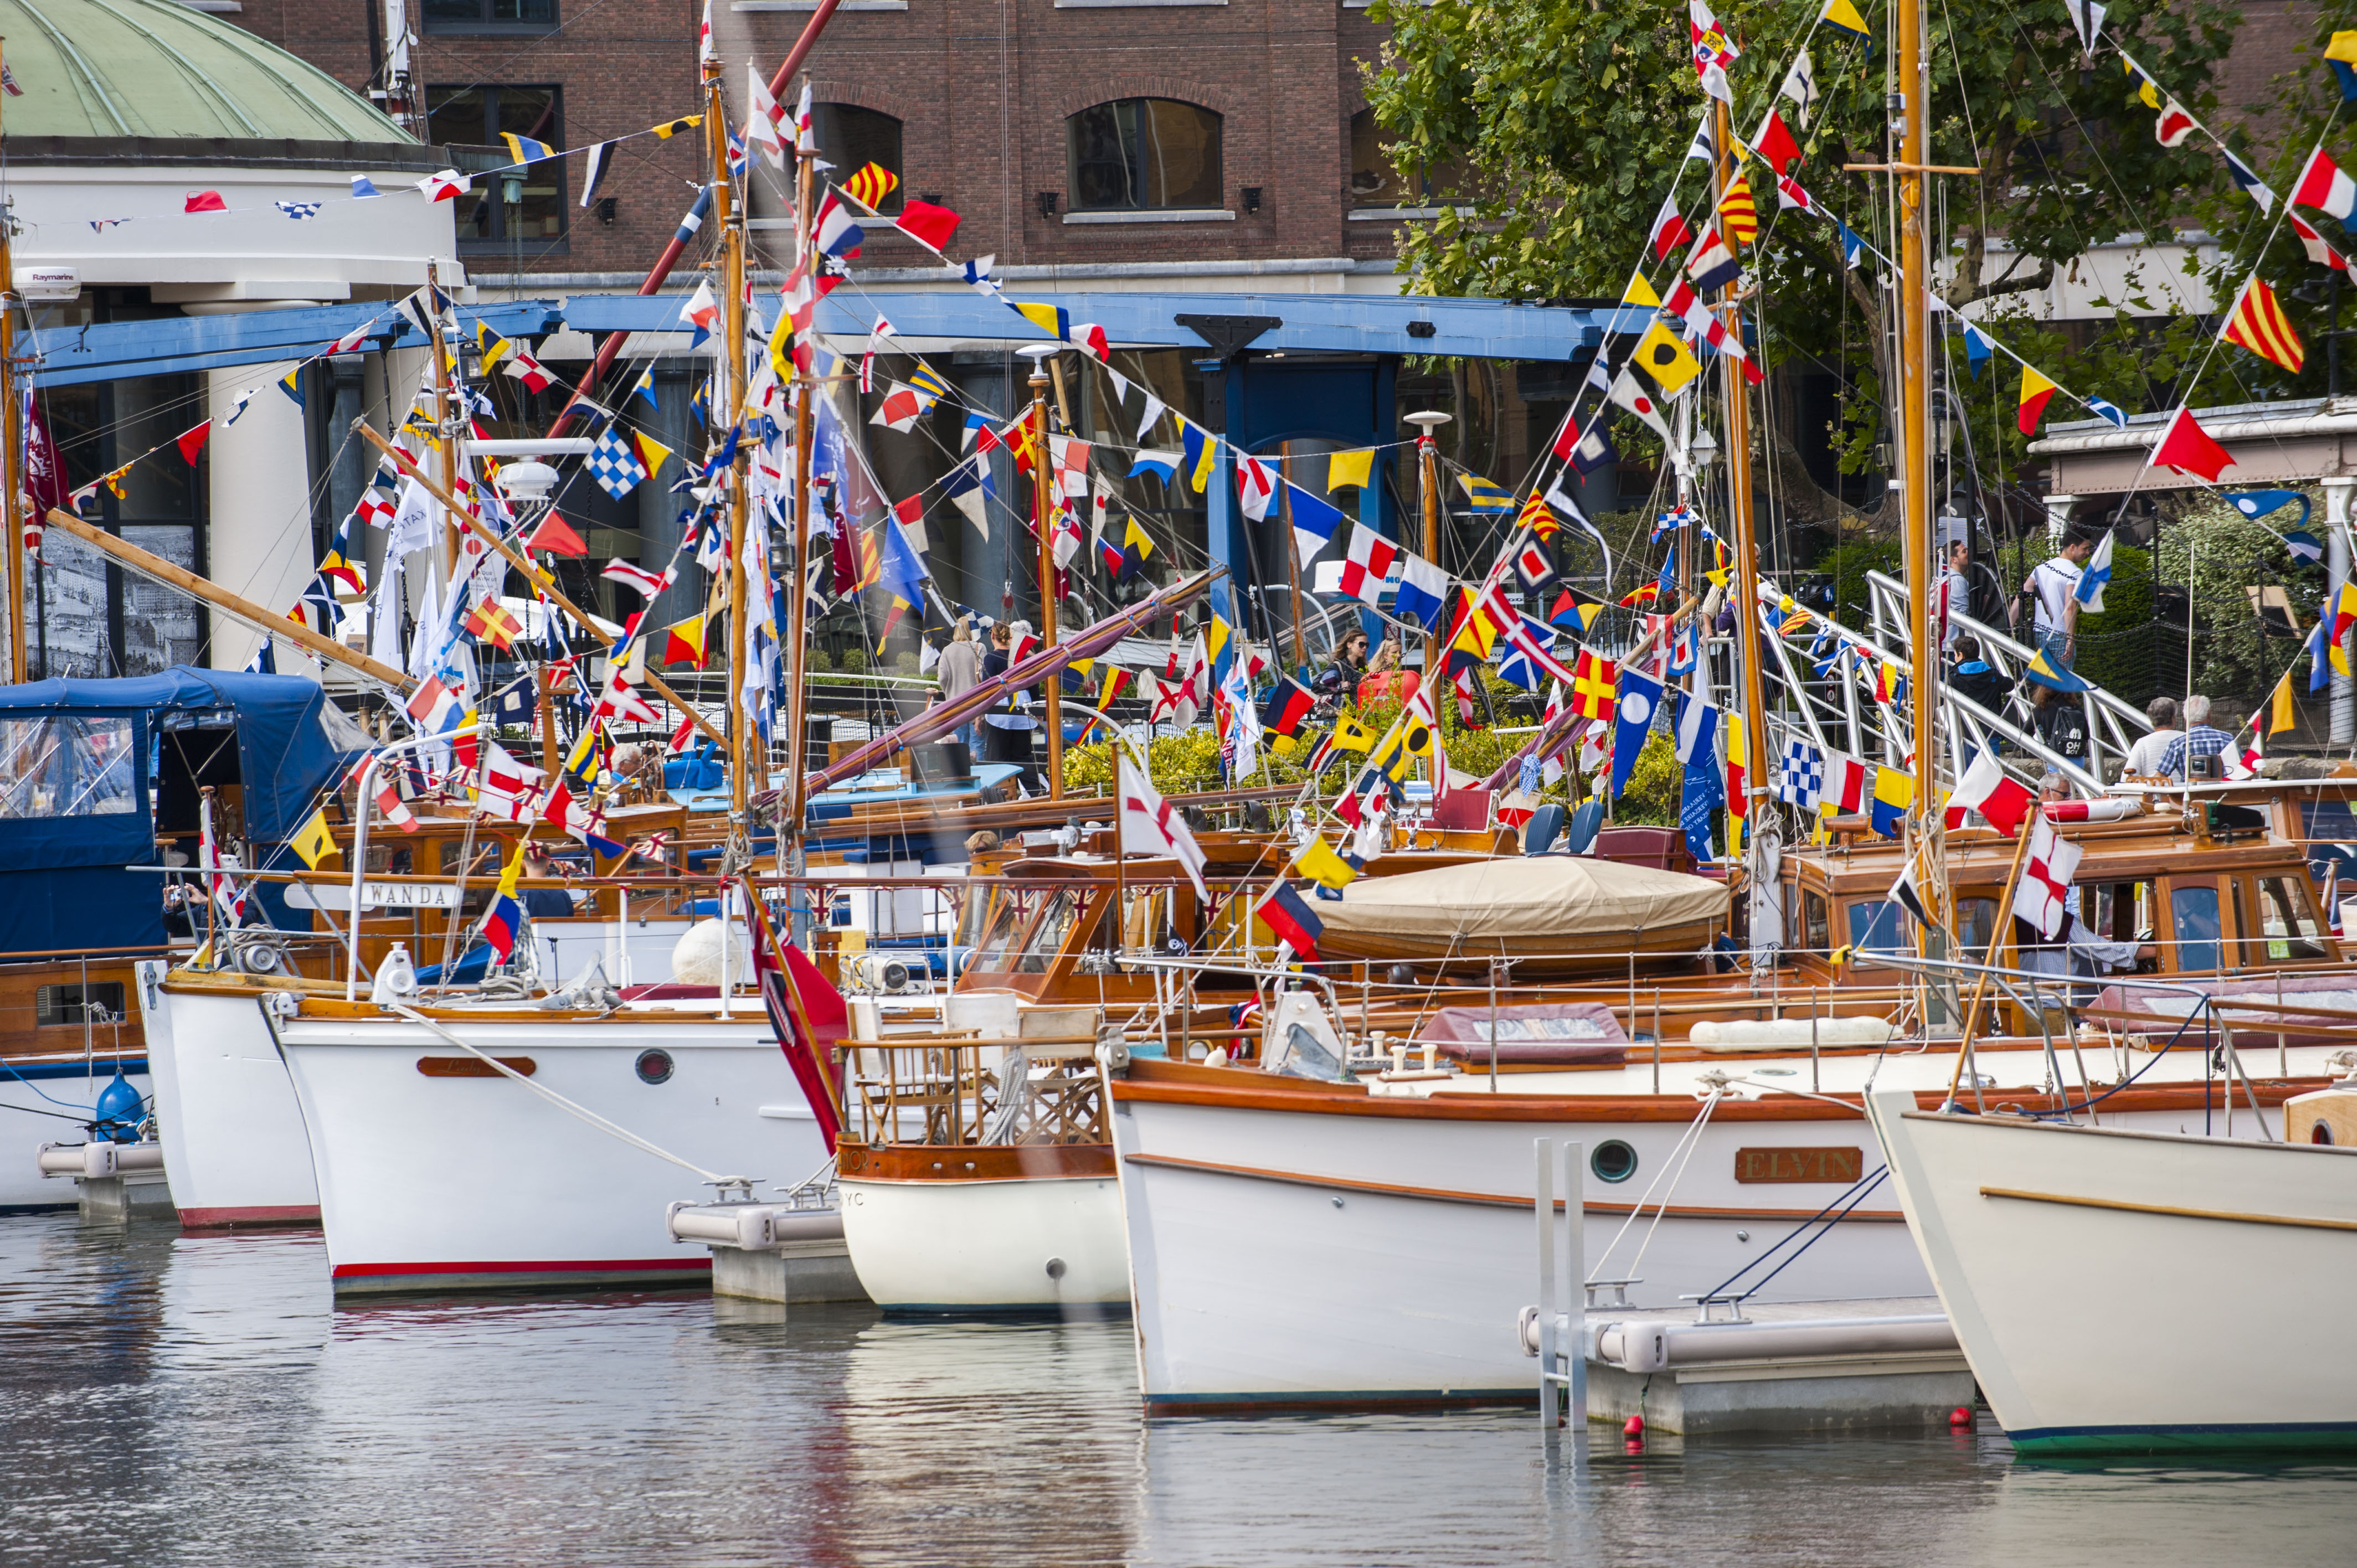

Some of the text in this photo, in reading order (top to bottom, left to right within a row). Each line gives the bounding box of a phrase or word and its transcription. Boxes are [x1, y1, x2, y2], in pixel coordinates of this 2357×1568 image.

[371, 885, 445, 904] WANDA
[438, 1058, 481, 1075] Lady
[1744, 1152, 1855, 1179] ELVIN
